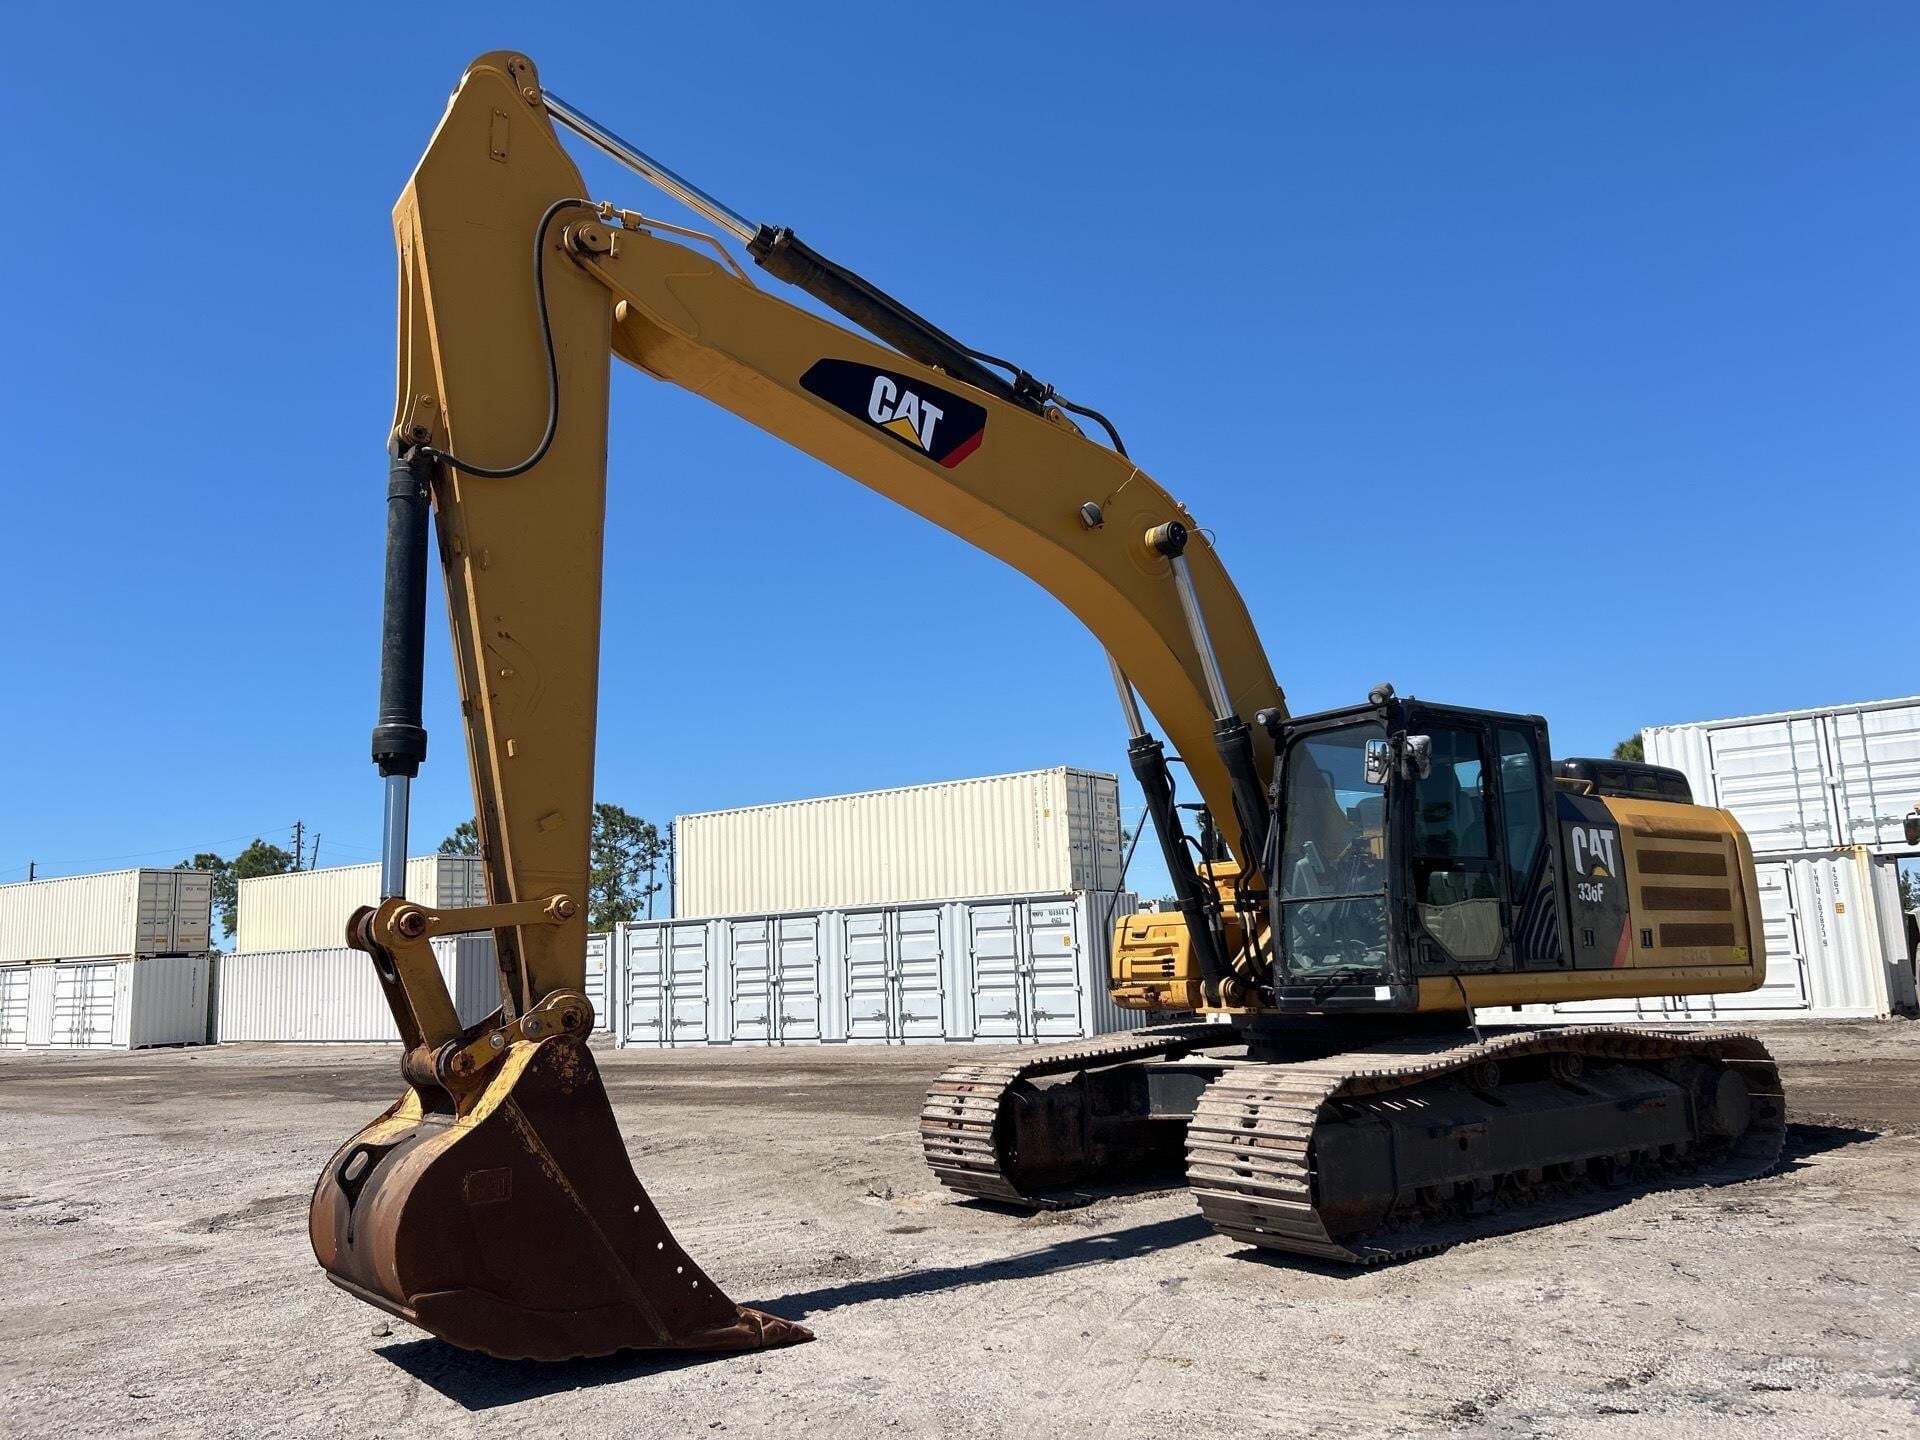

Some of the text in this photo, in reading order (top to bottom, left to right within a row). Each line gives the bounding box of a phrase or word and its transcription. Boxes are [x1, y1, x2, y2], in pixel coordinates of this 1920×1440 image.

[868, 375, 944, 452] CAT
[1572, 826, 1616, 878] CAT
[1577, 882, 1604, 903] 336F
